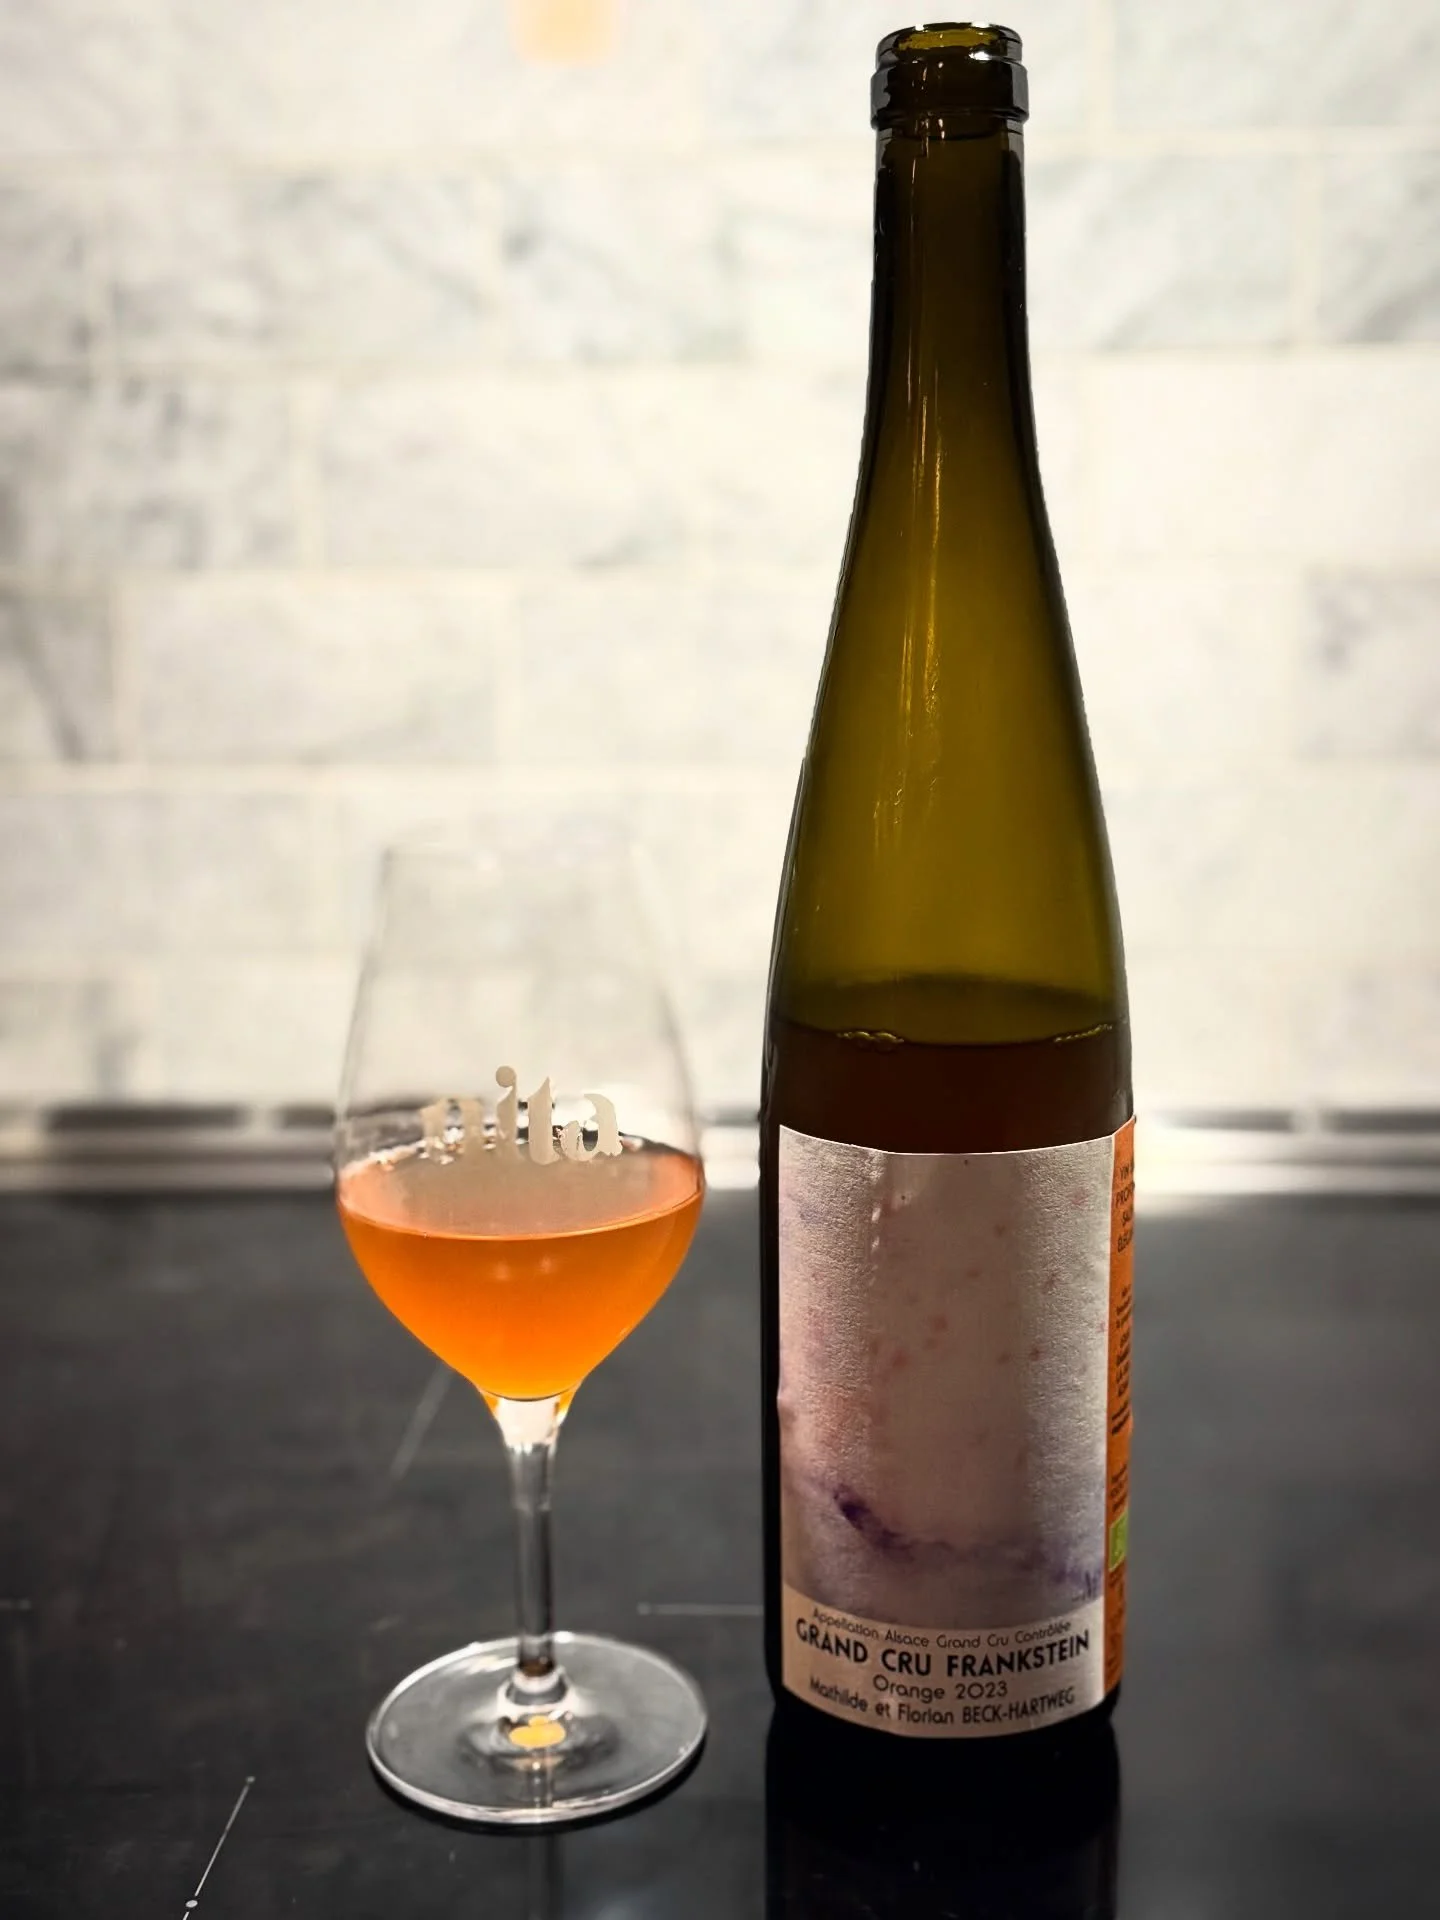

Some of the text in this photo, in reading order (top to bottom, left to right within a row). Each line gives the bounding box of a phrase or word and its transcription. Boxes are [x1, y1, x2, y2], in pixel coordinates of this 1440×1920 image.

[796, 1617, 1090, 1678] GRAND CRU FRANKSTEIN
[813, 1607, 879, 1640] Appellation
[885, 1629, 930, 1647] Alsace
[936, 1634, 981, 1649] Grand
[987, 1633, 1009, 1647] Cru
[809, 1676, 1076, 1725] Mathilde et Florian BECK-HARTWEG
[872, 1673, 1009, 1705] Orange 2023
